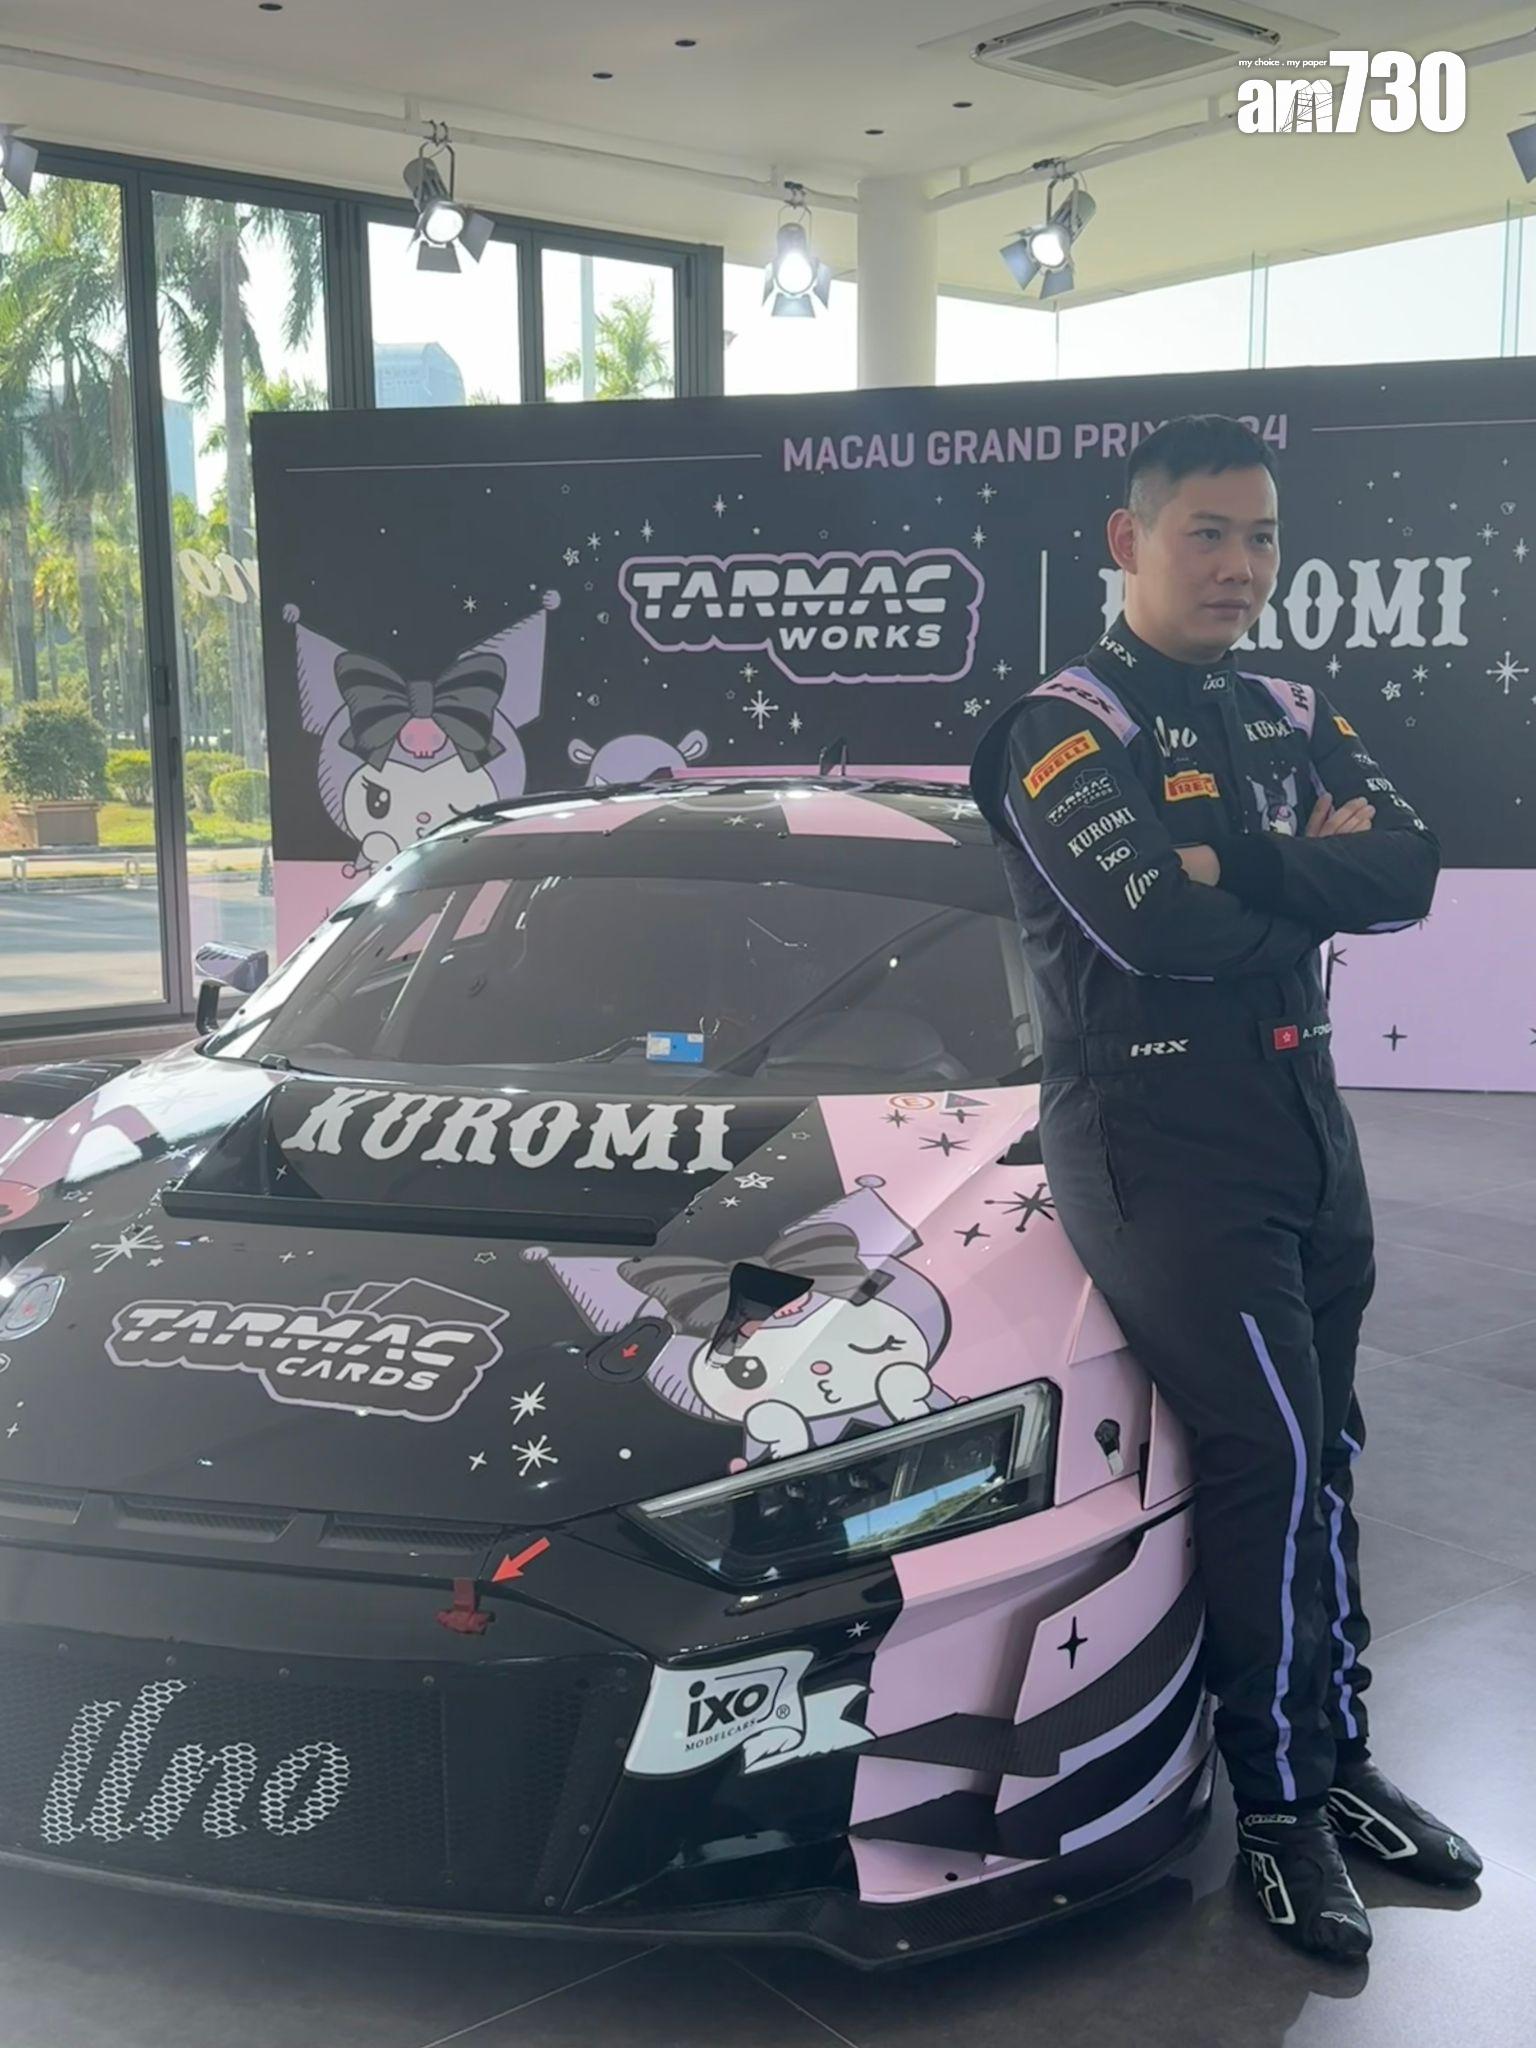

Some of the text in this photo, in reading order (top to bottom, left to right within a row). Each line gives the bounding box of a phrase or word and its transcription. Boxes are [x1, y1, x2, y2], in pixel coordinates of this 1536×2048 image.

[783, 432, 915, 472] MACAU
[927, 422, 1061, 466] GRAND
[632, 564, 952, 619] TARMAC
[1099, 556, 1472, 651] OMI
[779, 624, 942, 650] WORKS
[1099, 635, 1138, 668] HRX
[1067, 807, 1137, 858] KUROMI
[1095, 846, 1131, 872] ixo
[1130, 1038, 1190, 1057] HRX
[281, 1085, 736, 1172] KUROMI
[121, 1308, 476, 1367] TARMAC
[275, 1356, 441, 1391] CARDS
[687, 1680, 769, 1738] ixo
[684, 1717, 757, 1752] MODELCARS
